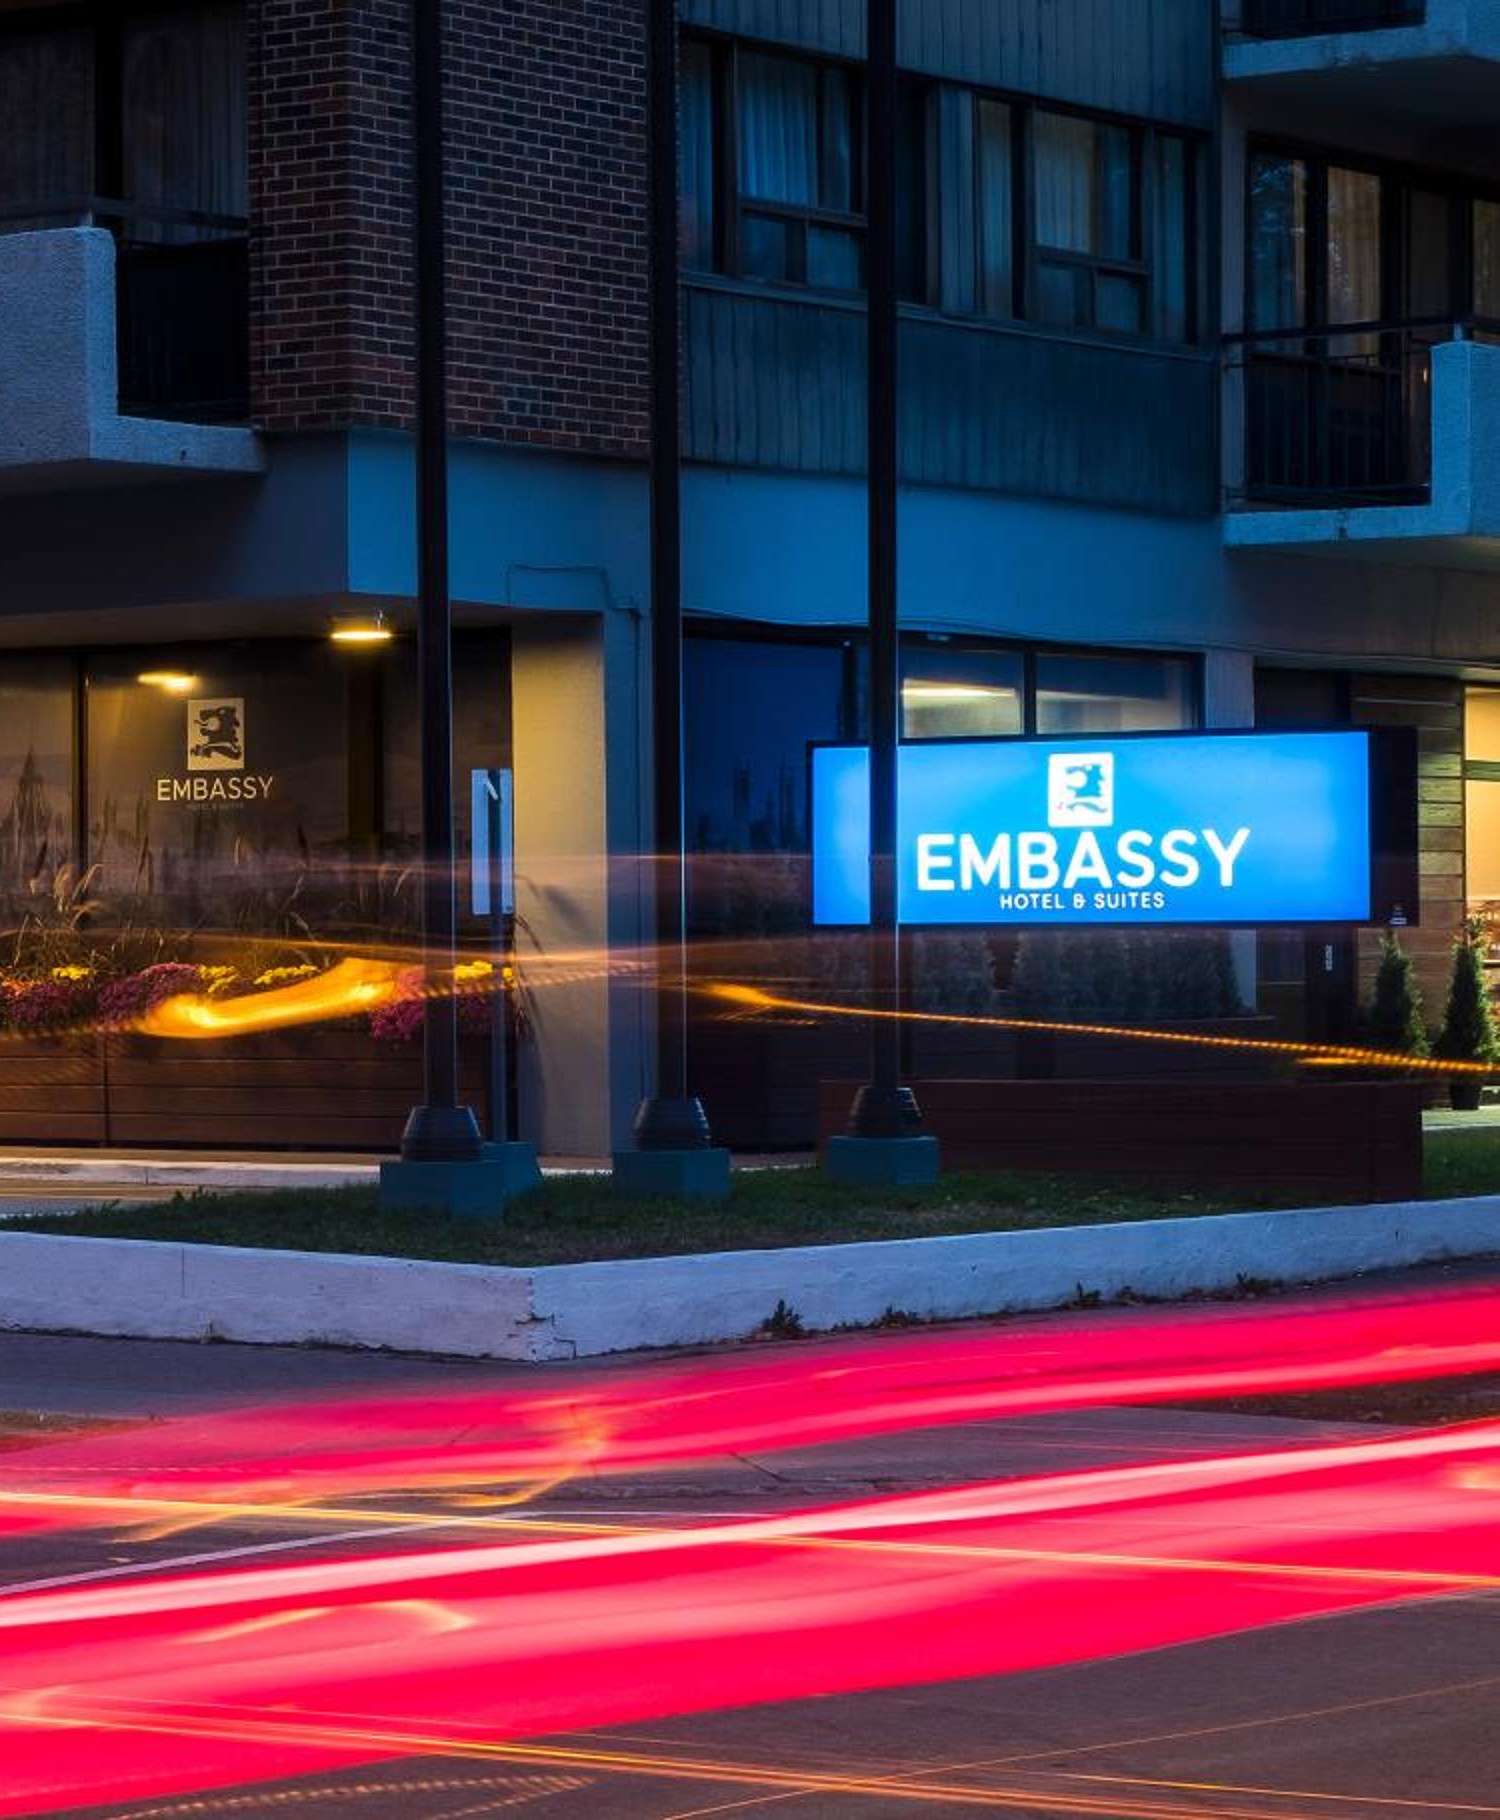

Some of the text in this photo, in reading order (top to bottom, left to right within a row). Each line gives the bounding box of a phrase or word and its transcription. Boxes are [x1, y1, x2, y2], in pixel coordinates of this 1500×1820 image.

[156, 776, 274, 801] EMBASSY
[916, 826, 1251, 892] EMBASSY
[999, 891, 1167, 911] HOTEL & SUITES
